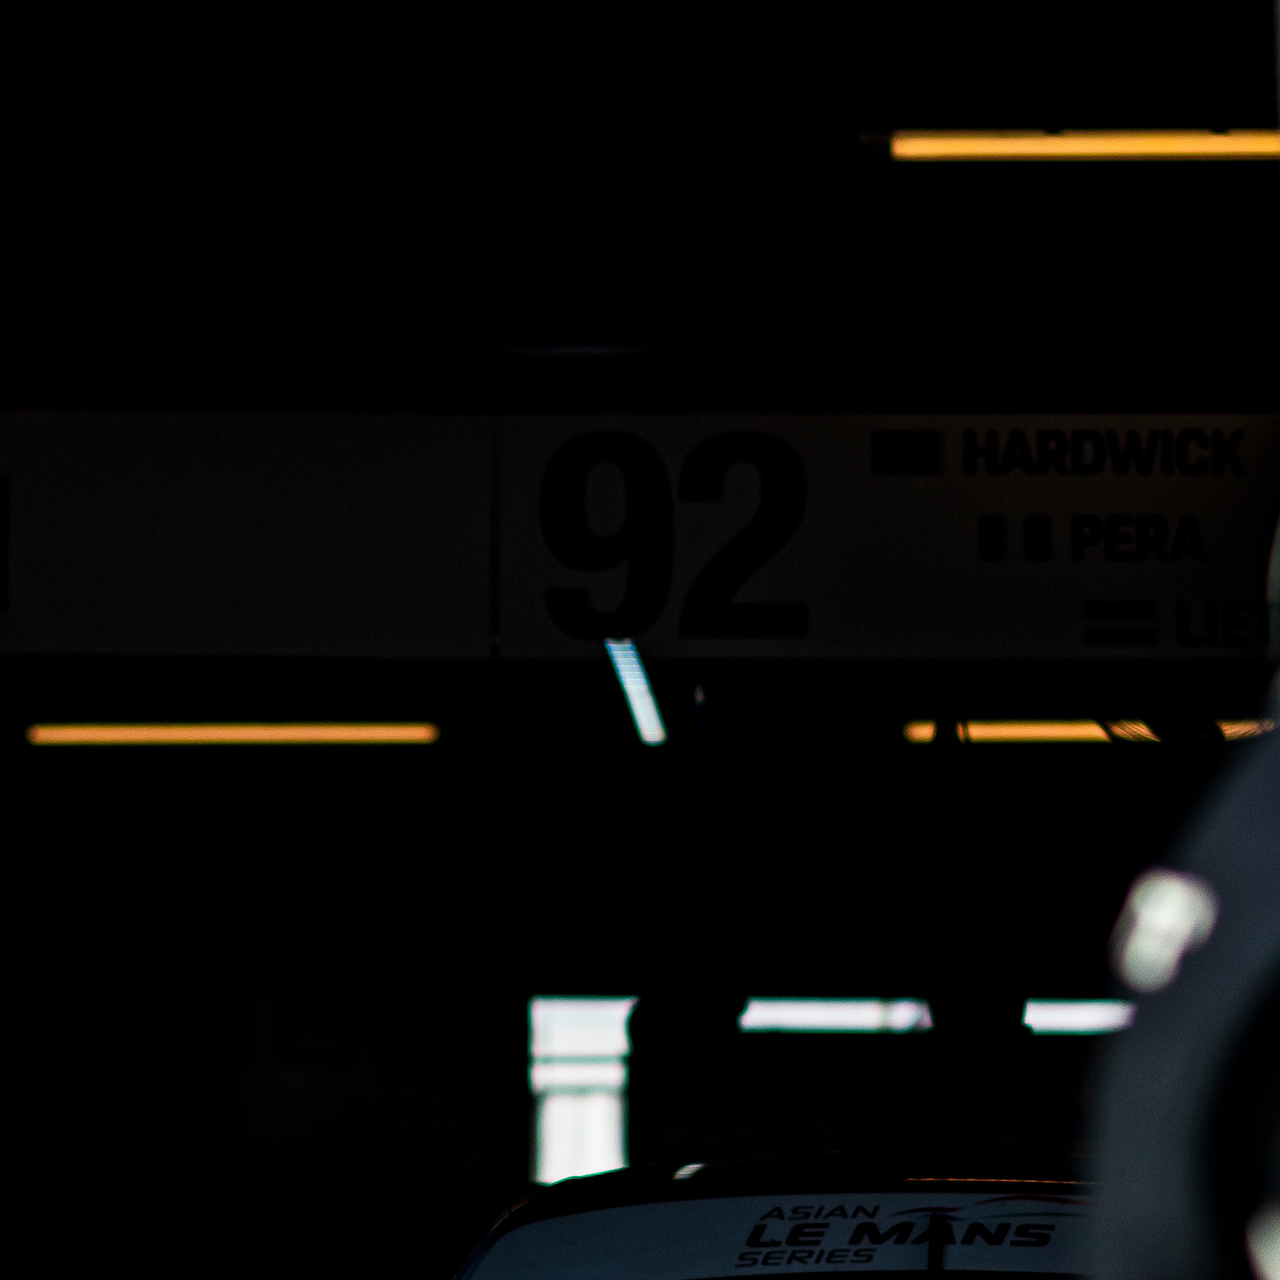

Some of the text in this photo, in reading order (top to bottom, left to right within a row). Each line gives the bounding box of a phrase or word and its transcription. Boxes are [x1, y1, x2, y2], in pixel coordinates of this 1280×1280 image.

[963, 429, 1246, 476] HARDWICK
[540, 431, 808, 639] 92
[1070, 515, 1207, 561] PERA
[759, 1205, 881, 1221] ASIAN
[745, 1222, 1056, 1248] LE MANS
[734, 1248, 878, 1268] SERIES
